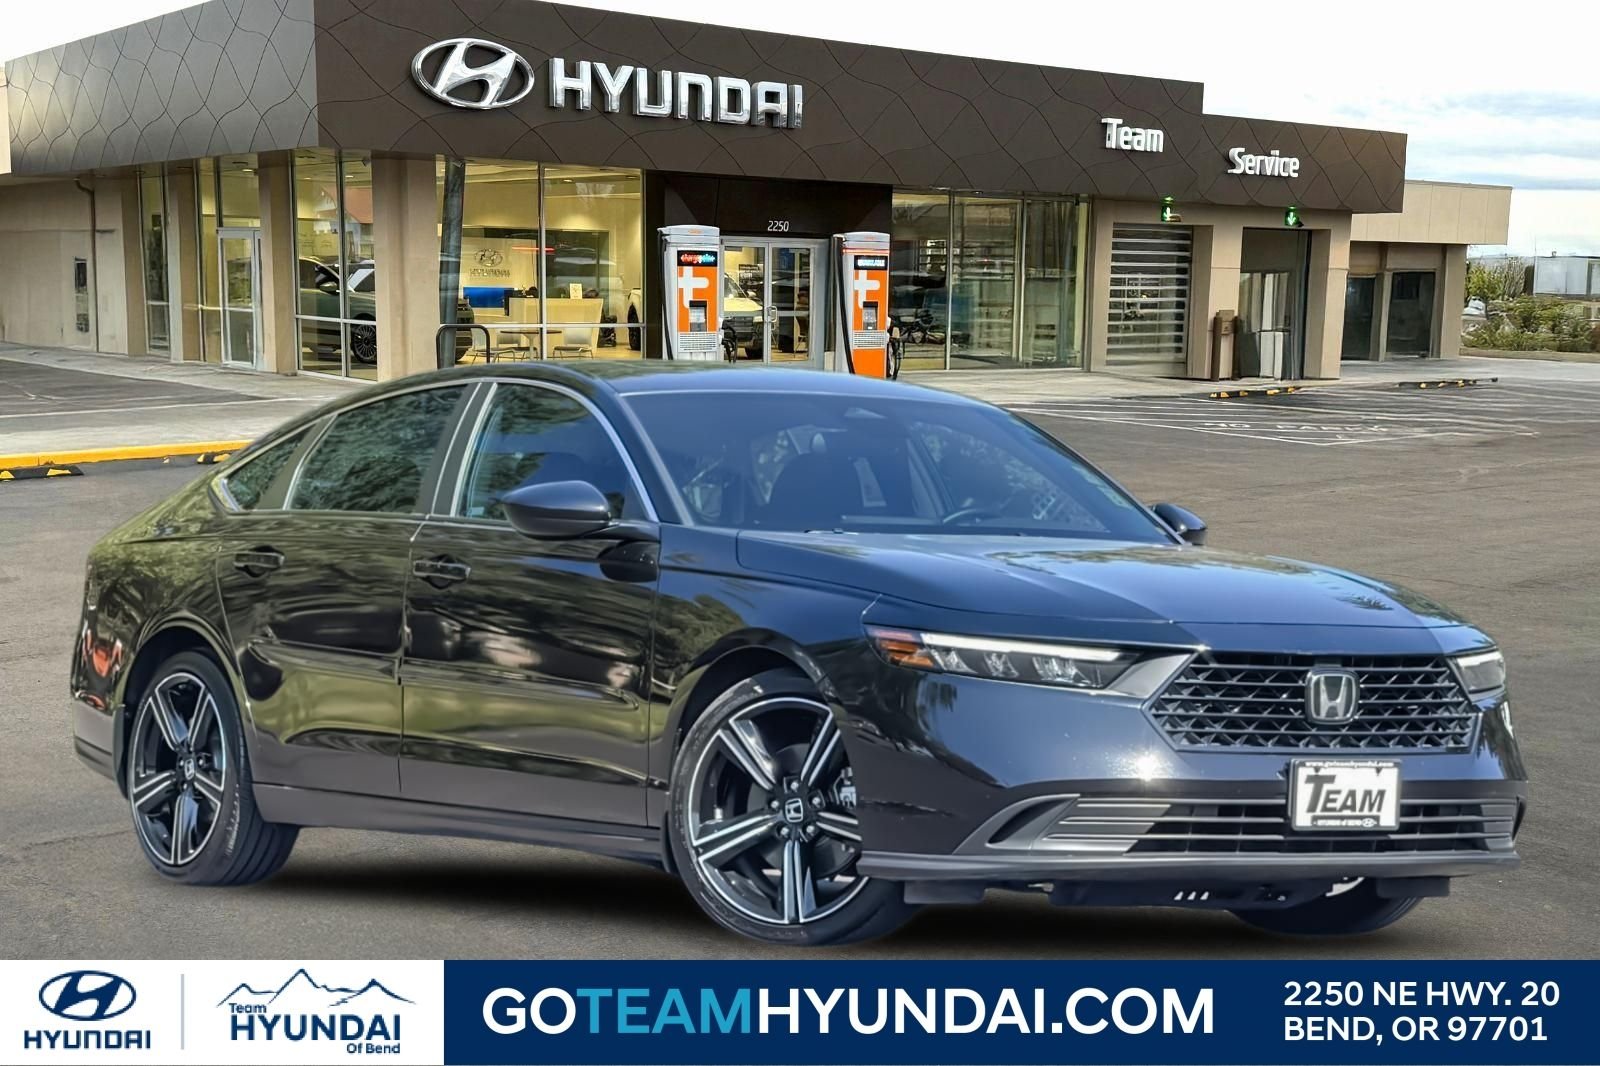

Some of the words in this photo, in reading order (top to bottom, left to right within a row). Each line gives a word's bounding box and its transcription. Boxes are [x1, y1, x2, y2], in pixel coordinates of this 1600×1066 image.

[548, 57, 803, 128] HYUNDAI
[1102, 117, 1164, 152] Team
[1227, 147, 1300, 178] Service
[767, 220, 790, 232] 2250
[1304, 774, 1387, 814] TEAM
